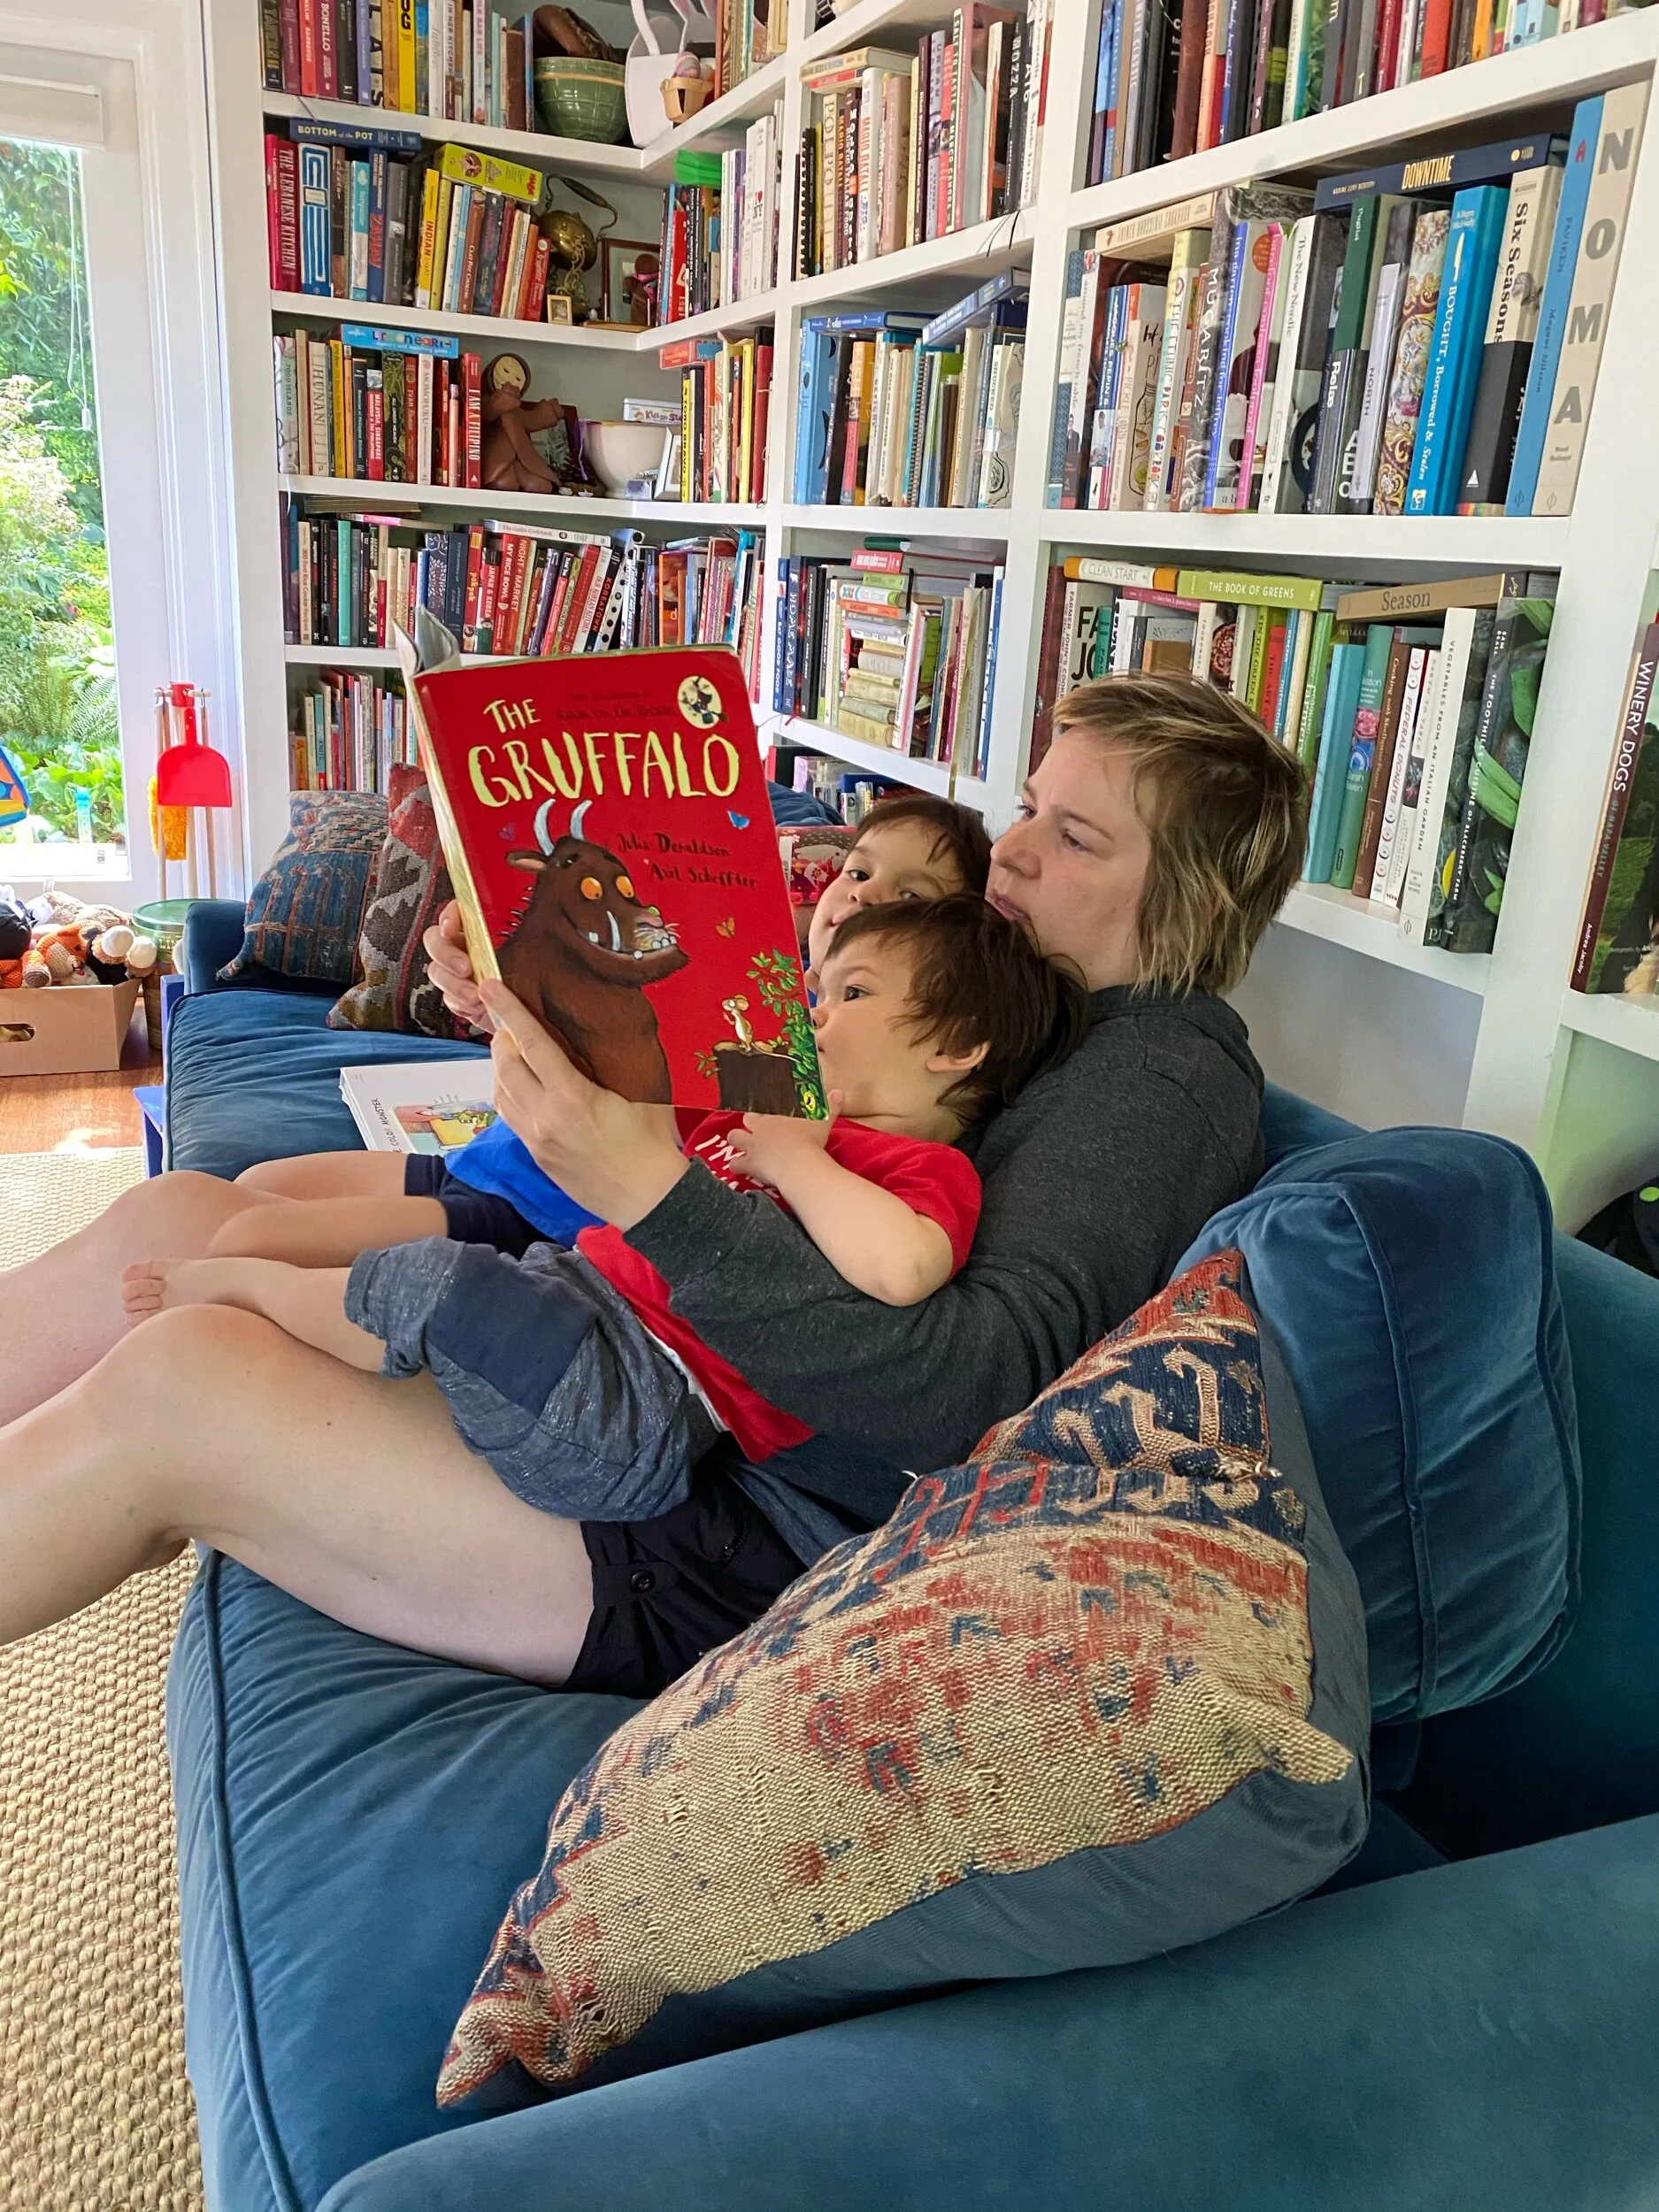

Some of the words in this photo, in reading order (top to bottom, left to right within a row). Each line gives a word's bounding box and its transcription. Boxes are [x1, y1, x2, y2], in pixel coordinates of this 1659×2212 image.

[321, 4, 332, 51] BONELLO
[952, 19, 961, 46] SALT
[1009, 35, 1023, 99] MOZZA
[297, 125, 338, 138] BOTTOM
[355, 130, 374, 141] POT
[823, 101, 836, 186] POLPO
[859, 117, 871, 152] MARIO
[279, 149, 295, 170] THE
[1401, 154, 1455, 191] DOWNTIME
[280, 172, 296, 223] LEBANESE
[753, 203, 764, 219] NY
[424, 219, 434, 257] INDIAN
[1507, 202, 1529, 244] Six
[281, 225, 297, 270] KITCHEN
[368, 213, 384, 269] ZAHAV
[1233, 236, 1244, 258] ina
[1295, 235, 1307, 259] The
[1292, 262, 1303, 292] New
[1492, 246, 1522, 345] Seasons
[1171, 301, 1182, 333] THE
[1286, 295, 1299, 337] Nordic
[1439, 285, 1460, 363] BOUGHT,
[1163, 334, 1179, 381] ETHNIC
[312, 367, 326, 425] HUNAN
[421, 372, 430, 426] MOMOFUKU
[468, 396, 481, 411] AM
[989, 361, 999, 411] SHUCKED
[1159, 386, 1173, 420] PARIS
[1246, 365, 1263, 435] foolproof
[1363, 365, 1377, 416] NORTH
[1425, 365, 1446, 427] Borrowed
[645, 409, 659, 420] Kids
[467, 421, 480, 461] FILIPINO
[1424, 429, 1435, 443] &
[1417, 445, 1432, 480] Stolen
[505, 542, 514, 555] MY
[517, 539, 528, 567] NIGHT
[487, 565, 497, 588] JAPAN
[503, 557, 512, 576] RICE
[1087, 563, 1113, 580] CLEAN
[1115, 566, 1139, 581] START
[500, 576, 511, 600] BOWL
[511, 575, 524, 612] MARKET
[588, 589, 602, 610] KOREAN
[591, 576, 613, 632] KOREATOWN
[1209, 580, 1223, 593] THE
[1225, 582, 1247, 595] BOOK
[1248, 584, 1260, 595] OF
[1263, 585, 1294, 600] GREENS
[1381, 591, 1432, 612] Season
[484, 596, 494, 619] KOREA
[581, 611, 595, 634] KITCHEN
[787, 592, 798, 639] HOME
[1254, 636, 1263, 657] THE
[1493, 630, 1502, 656] BEALL
[785, 641, 795, 687] MADE
[1250, 659, 1260, 696] GREEN
[1268, 655, 1277, 677] THE
[1386, 657, 1400, 696] Cooking
[1440, 640, 1456, 706] VEGETABLES
[1488, 672, 1497, 691] THE
[1263, 683, 1274, 704] ART
[1383, 697, 1394, 716] with
[1624, 660, 1654, 737] WINERY
[483, 698, 541, 733] THE
[1397, 696, 1414, 751] FEDERAL
[1434, 710, 1447, 741] FROM
[1474, 693, 1495, 757] FOOTHILLS
[1432, 743, 1440, 759] AN
[1612, 739, 1636, 793] DOGS
[467, 731, 740, 808] GRUFFALO
[1389, 753, 1405, 805] DONUTS
[1424, 763, 1438, 805] ITALIAN
[1467, 760, 1484, 806] CUISINE
[1417, 808, 1432, 851] GARDEN
[1465, 810, 1475, 822] OF
[618, 833, 650, 854] Julia
[653, 832, 732, 857] Donaldson
[1455, 824, 1471, 875] BLACKBERRY
[649, 863, 682, 883] Axel
[1452, 877, 1463, 901] FARM
[1581, 922, 1594, 949] Andrea
[1576, 949, 1587, 974] Jacoby
